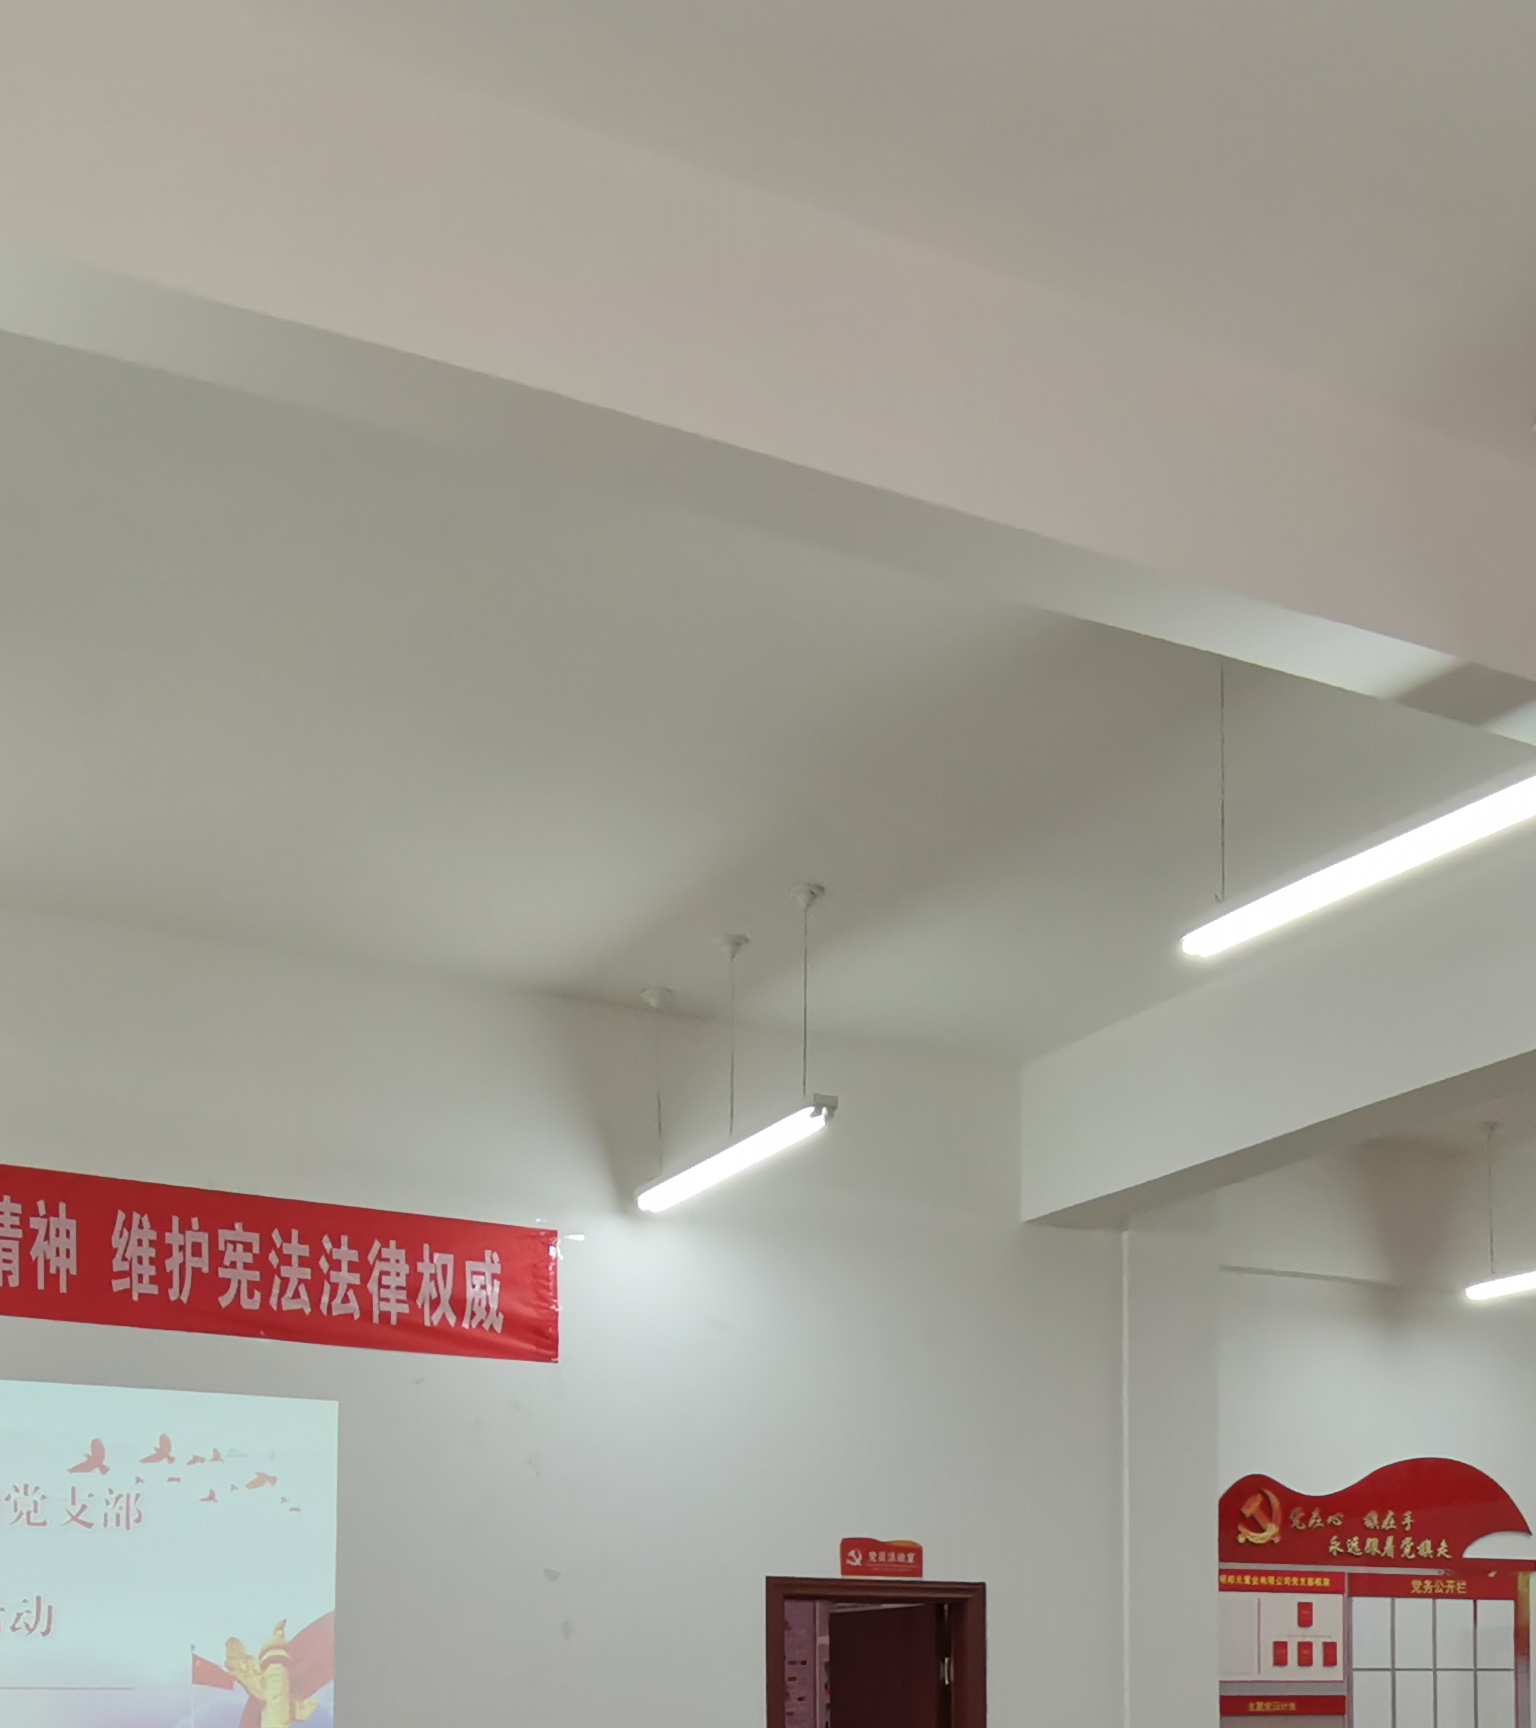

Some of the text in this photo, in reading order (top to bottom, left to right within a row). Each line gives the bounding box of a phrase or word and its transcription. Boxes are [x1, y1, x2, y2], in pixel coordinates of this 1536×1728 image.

[111, 1209, 504, 1334] 维护宪法法律权威
[1410, 1579, 1468, 1595] 党务公开栏
